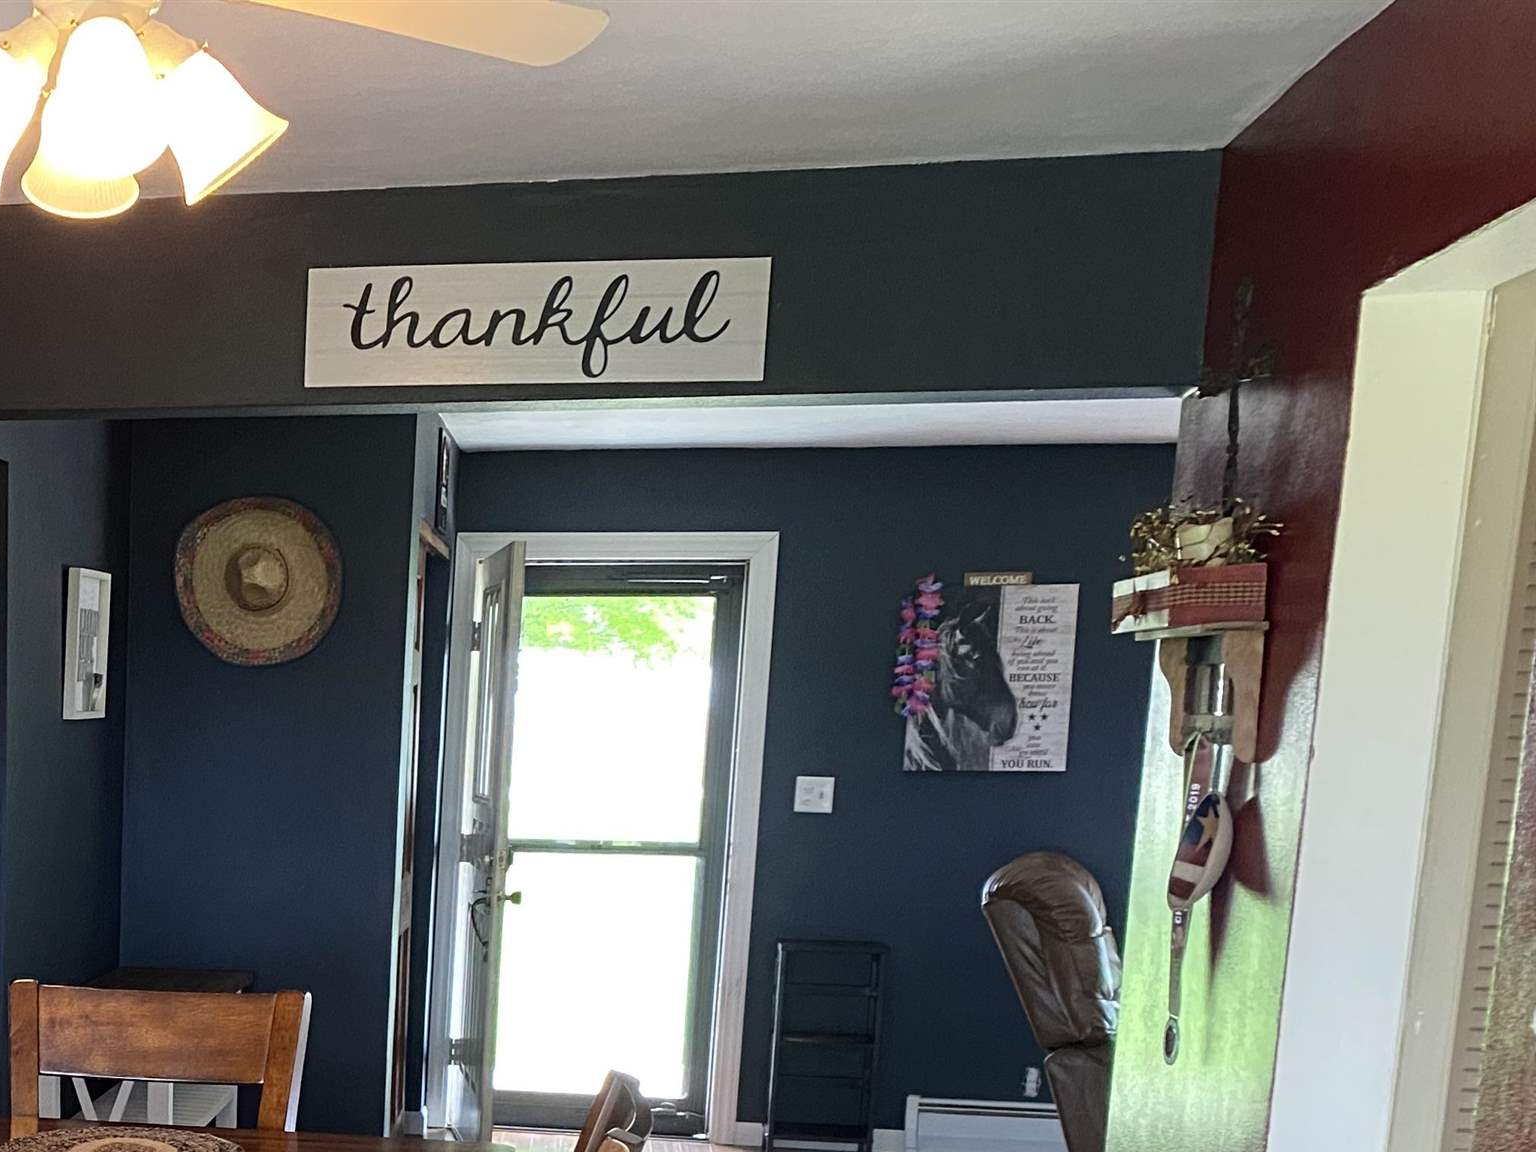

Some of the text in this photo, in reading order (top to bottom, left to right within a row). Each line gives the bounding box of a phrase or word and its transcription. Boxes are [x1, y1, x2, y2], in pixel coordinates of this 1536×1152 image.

[343, 269, 731, 379] thankful
[969, 575, 1027, 586] WELCOME
[1009, 673, 1061, 682] BECAUSE
[1001, 759, 1024, 769] YOU
